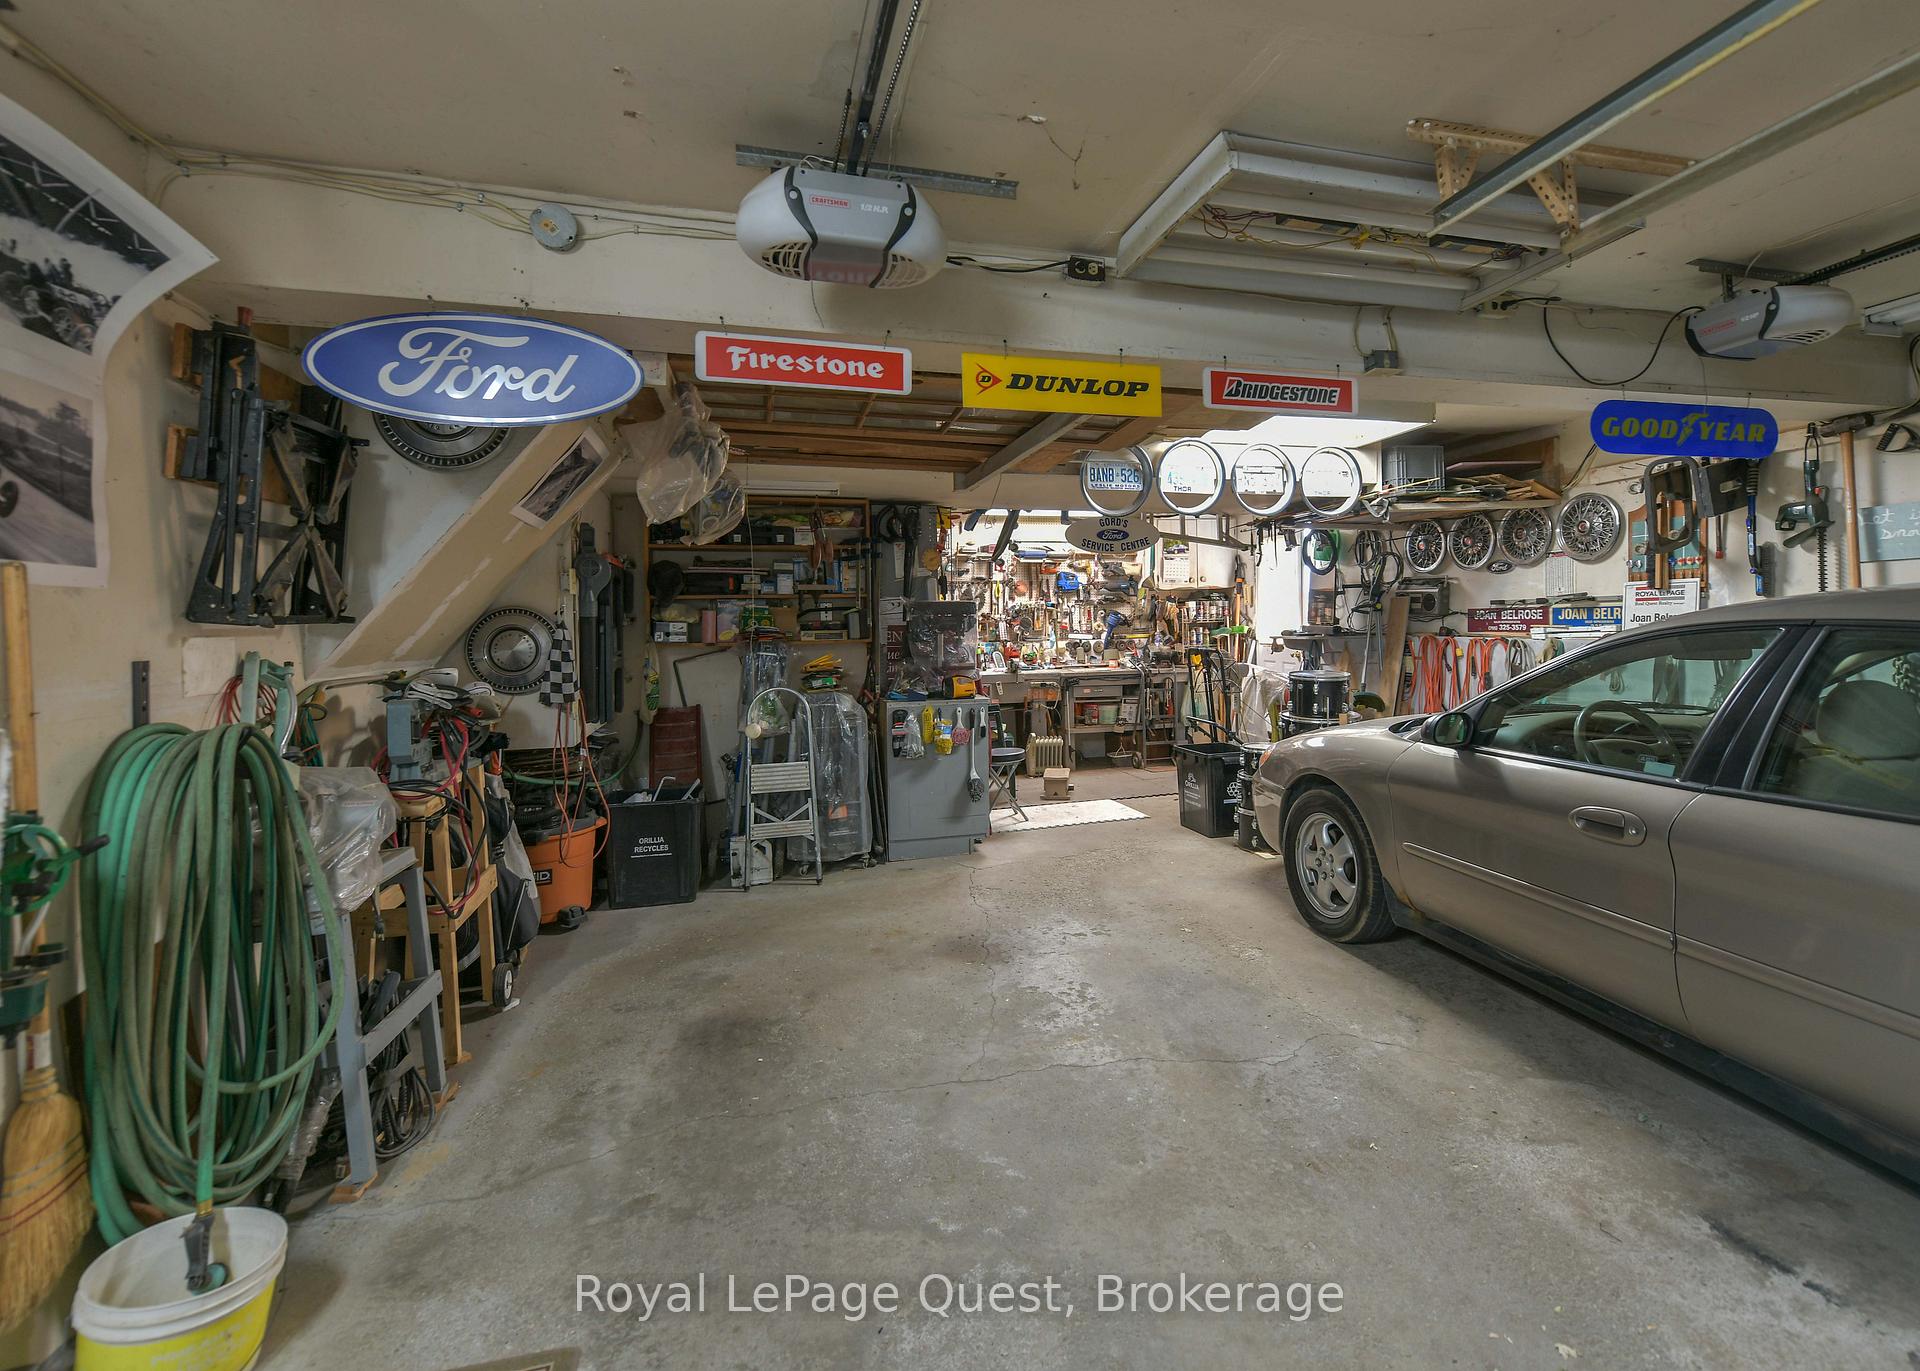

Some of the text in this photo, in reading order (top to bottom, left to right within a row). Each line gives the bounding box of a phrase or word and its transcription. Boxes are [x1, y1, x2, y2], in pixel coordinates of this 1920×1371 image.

[811, 196, 849, 207] CRAFTSMAN
[378, 327, 579, 403] Ford
[726, 345, 884, 379] Firestone
[979, 373, 1150, 397] D DUNLOP
[1224, 378, 1339, 404] BRIDGESTONE
[1120, 468, 1140, 483] 526
[1099, 517, 1129, 528] GORD'S
[1102, 530, 1124, 540] Ford
[1880, 529, 1920, 540] sno
[1081, 536, 1151, 552] SERVICE CENTRE
[1474, 609, 1544, 620] JOAN BELROSE
[1558, 607, 1622, 620] JOAN BELR
[1630, 613, 1652, 623] Joan
[638, 836, 665, 844] ORILLIA
[634, 844, 669, 853] RECYCLES
